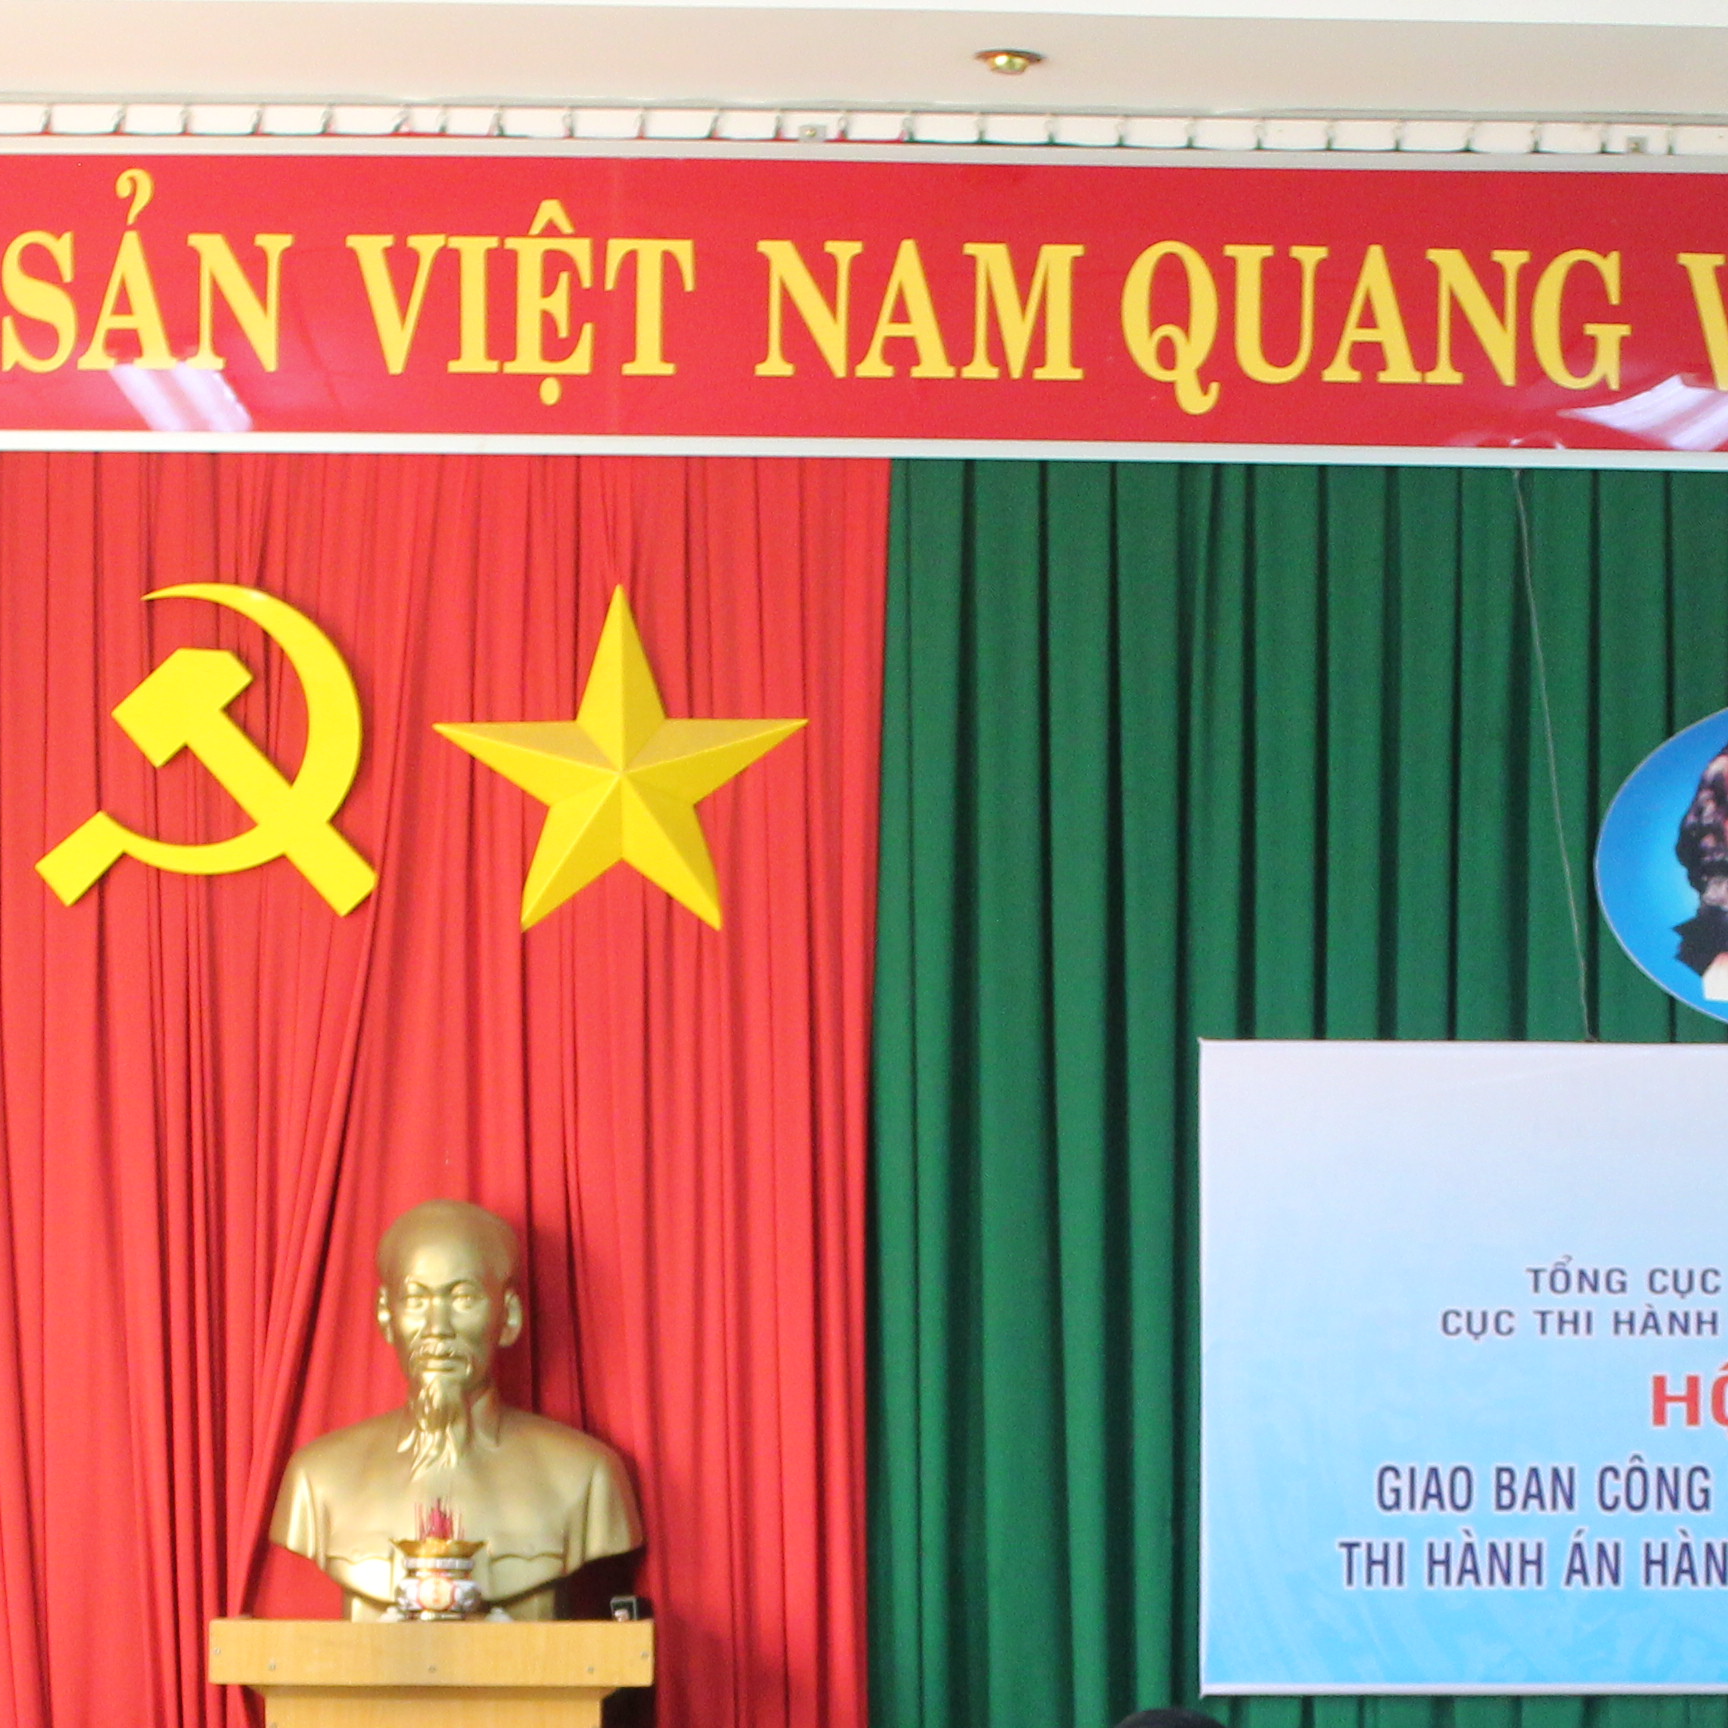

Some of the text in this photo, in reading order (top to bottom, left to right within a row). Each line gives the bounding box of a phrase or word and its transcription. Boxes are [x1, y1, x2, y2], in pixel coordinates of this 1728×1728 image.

[0, 167, 295, 375] SẢN
[344, 198, 696, 407] VIỆT
[754, 238, 1086, 381] NAM
[1120, 239, 1632, 416] QUANG
[1526, 1254, 1628, 1296] TỔNG
[1647, 1267, 1722, 1299] CỤC
[1441, 1309, 1515, 1341] CỤC
[1534, 1309, 1593, 1336] THI
[1612, 1303, 1718, 1336] HÀNH
[1376, 1464, 1474, 1513] GIAO
[1493, 1464, 1576, 1512] BAN
[1597, 1452, 1711, 1513] CÔNG
[1338, 1540, 1406, 1587] THI
[1426, 1528, 1544, 1587] HÀNH
[1564, 1528, 1622, 1587] ÁN
